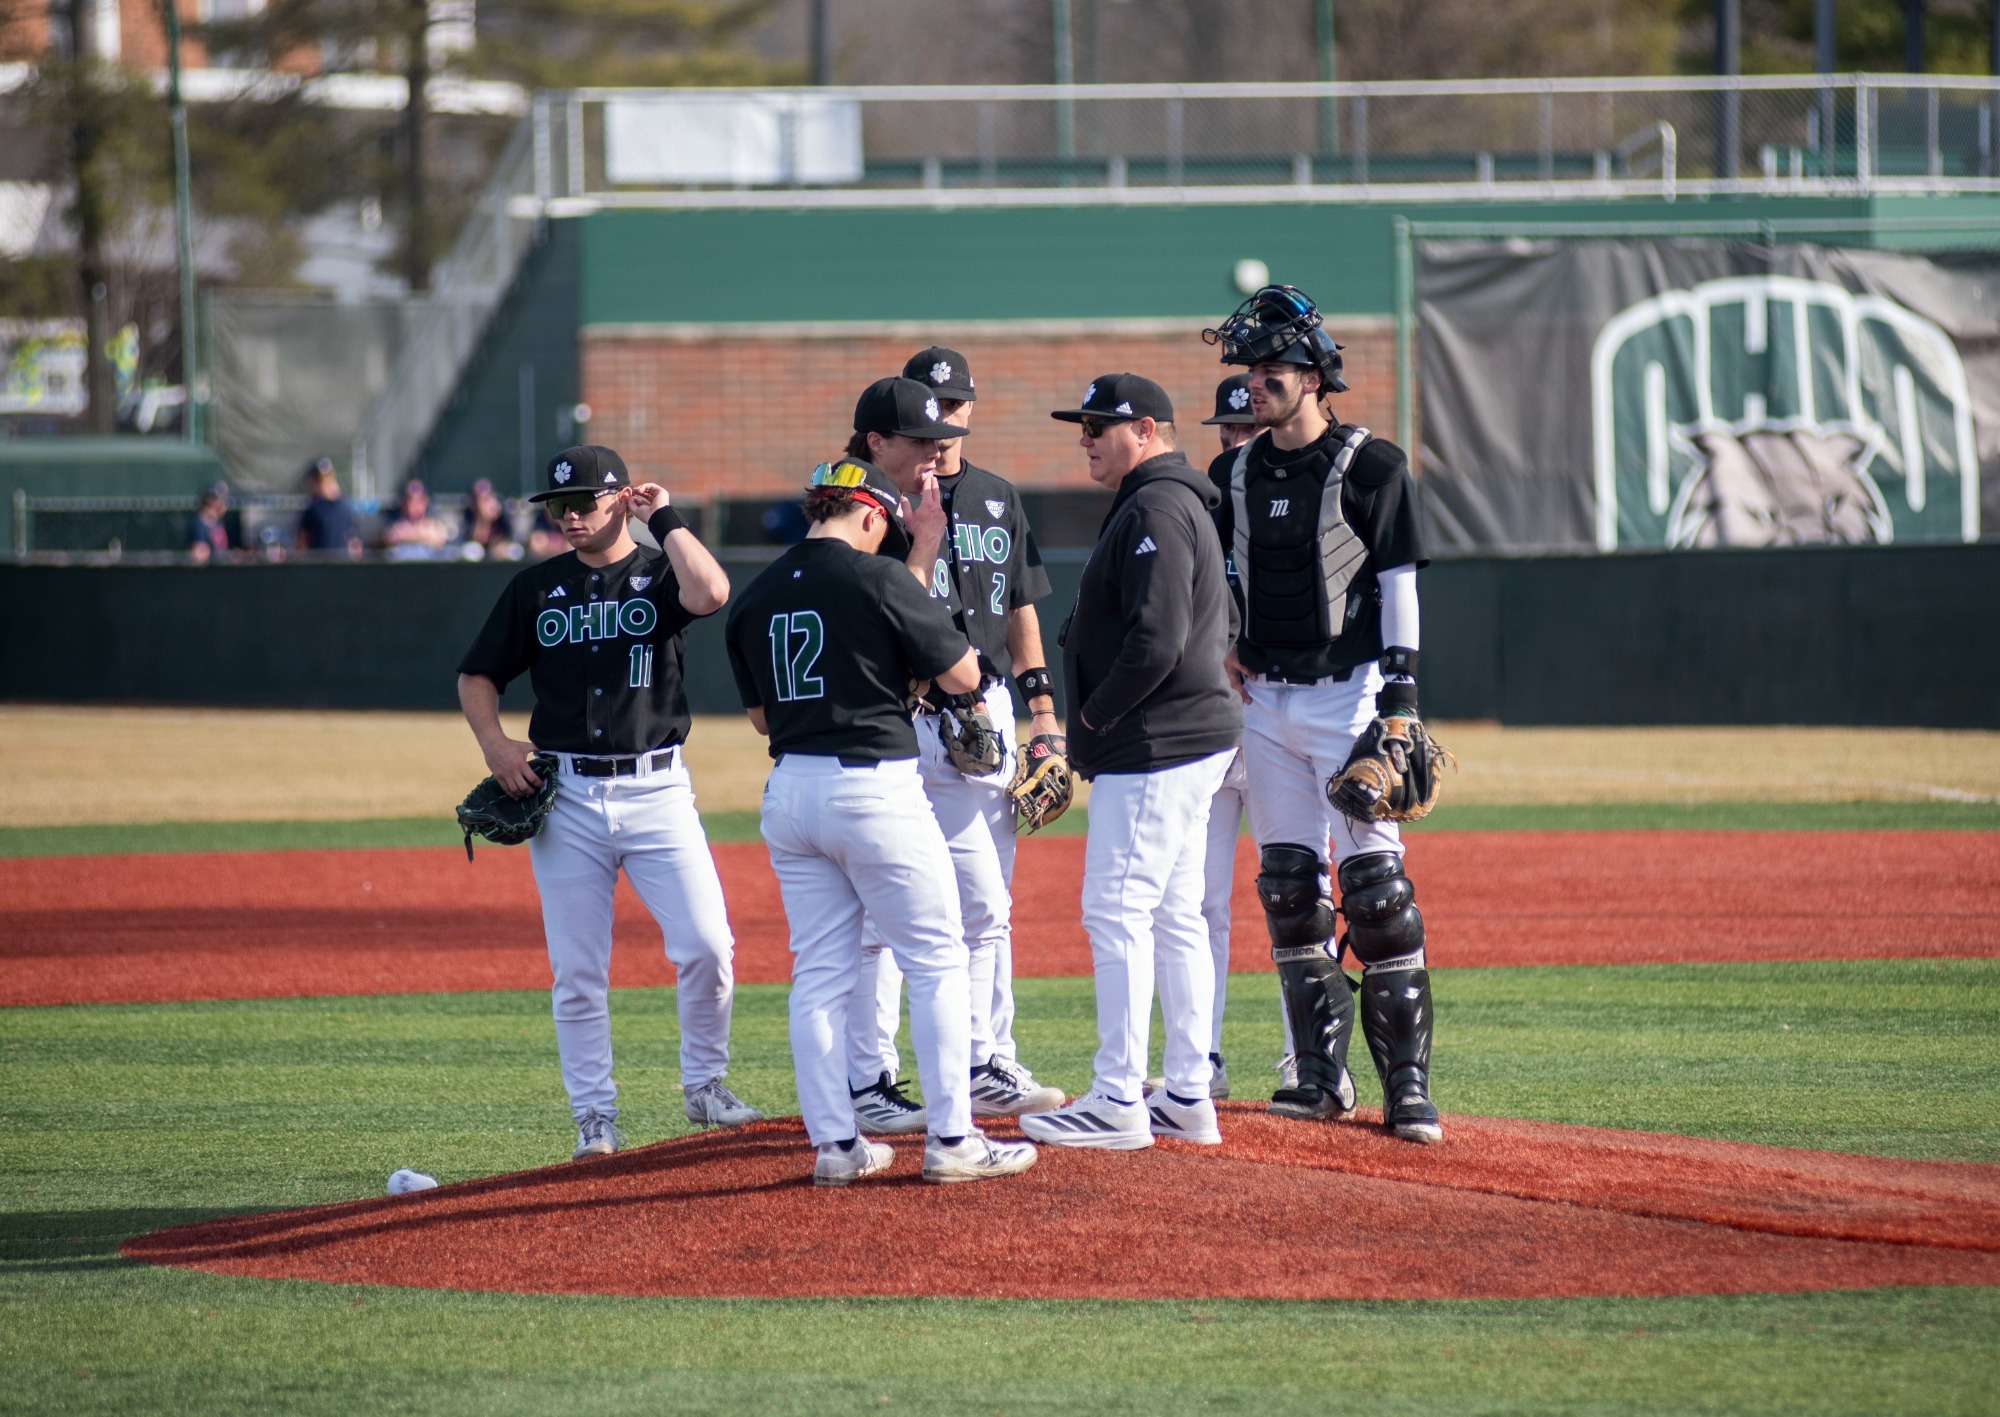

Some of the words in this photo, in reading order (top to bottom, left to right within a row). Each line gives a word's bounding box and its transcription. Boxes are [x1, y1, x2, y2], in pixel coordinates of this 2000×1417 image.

[946, 524, 1011, 564] HIO
[991, 572, 1006, 615] 2
[537, 598, 657, 647] OHIO
[629, 644, 653, 688] 11
[769, 611, 824, 702] 12
[1275, 946, 1315, 960] marucci
[1376, 955, 1418, 970] marucci
